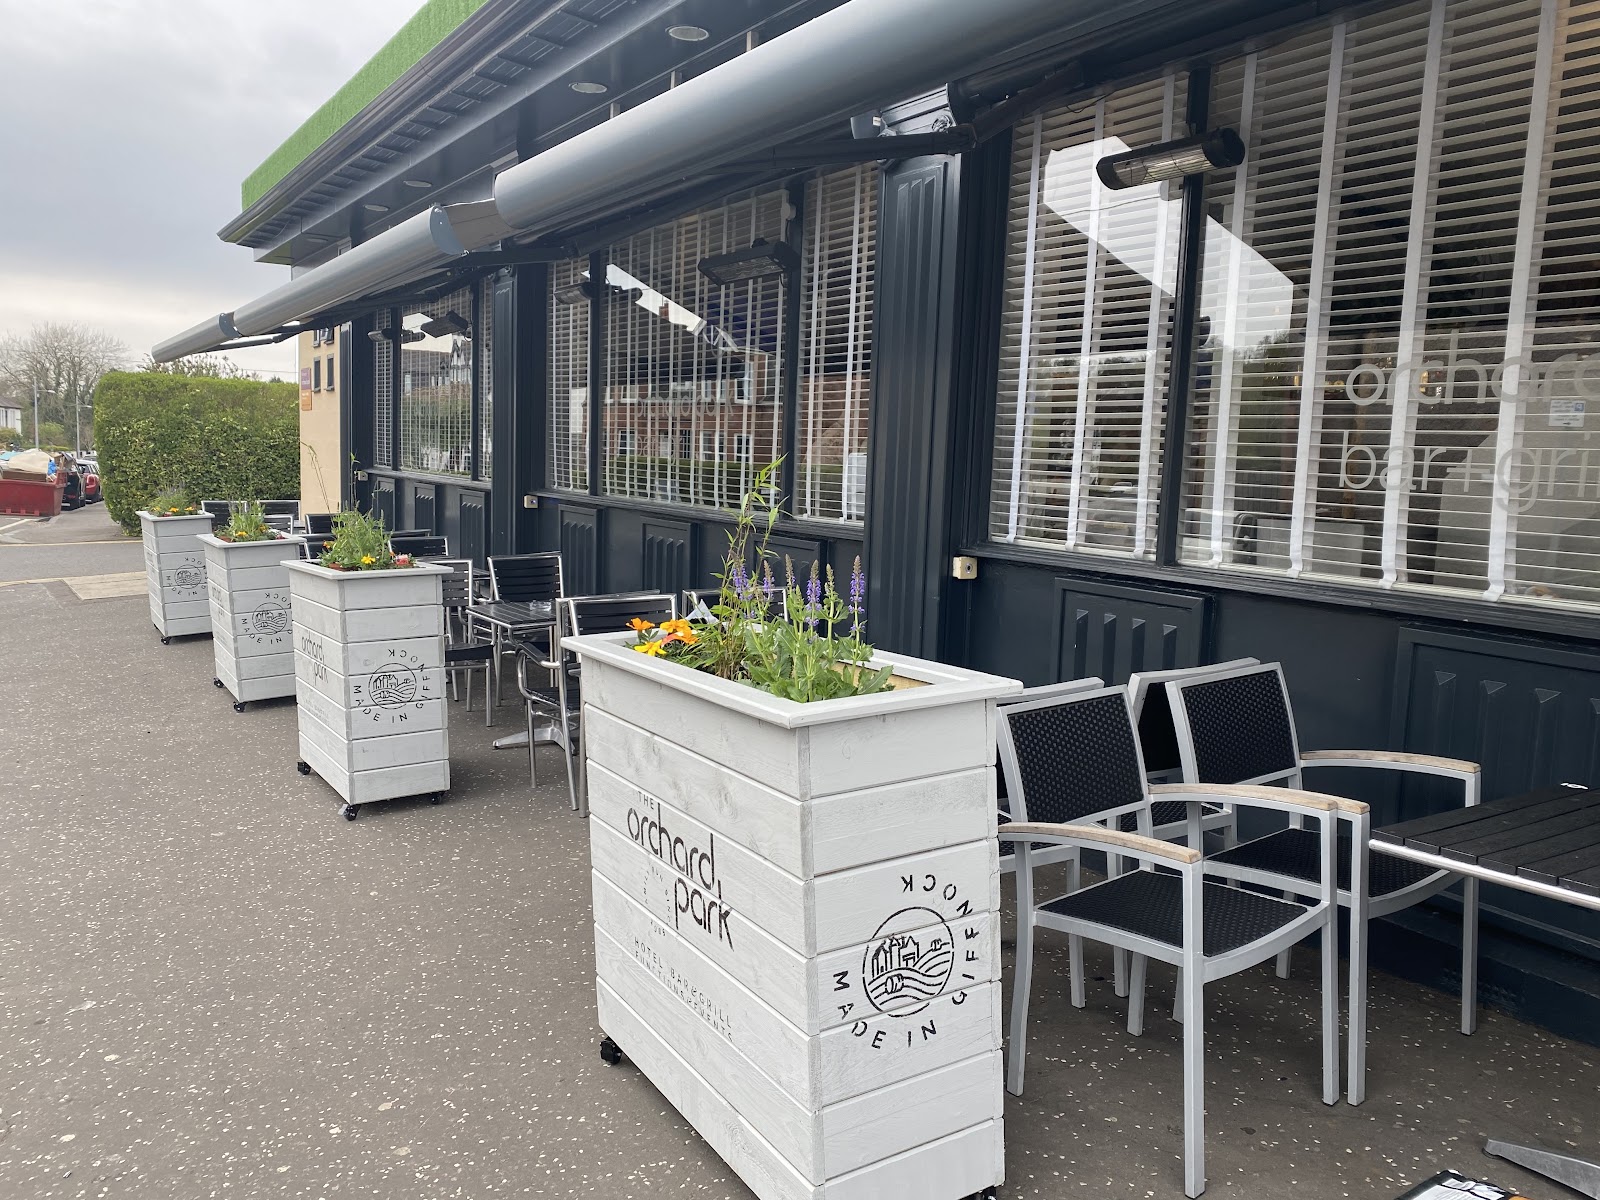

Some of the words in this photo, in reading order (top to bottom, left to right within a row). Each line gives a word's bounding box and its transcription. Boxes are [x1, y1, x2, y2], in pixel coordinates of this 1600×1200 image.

[241, 618, 262, 643] MADE
[388, 649, 431, 709] GIFFNOCK
[353, 685, 382, 721] MADE
[391, 713, 409, 723] IN
[637, 790, 655, 810] THE
[627, 802, 715, 891] orchard
[674, 878, 734, 950] park
[634, 936, 663, 969] HOTEL
[901, 874, 980, 1006] GIFFNOCK
[833, 970, 887, 1049] MADE
[906, 1019, 937, 1048] IN
